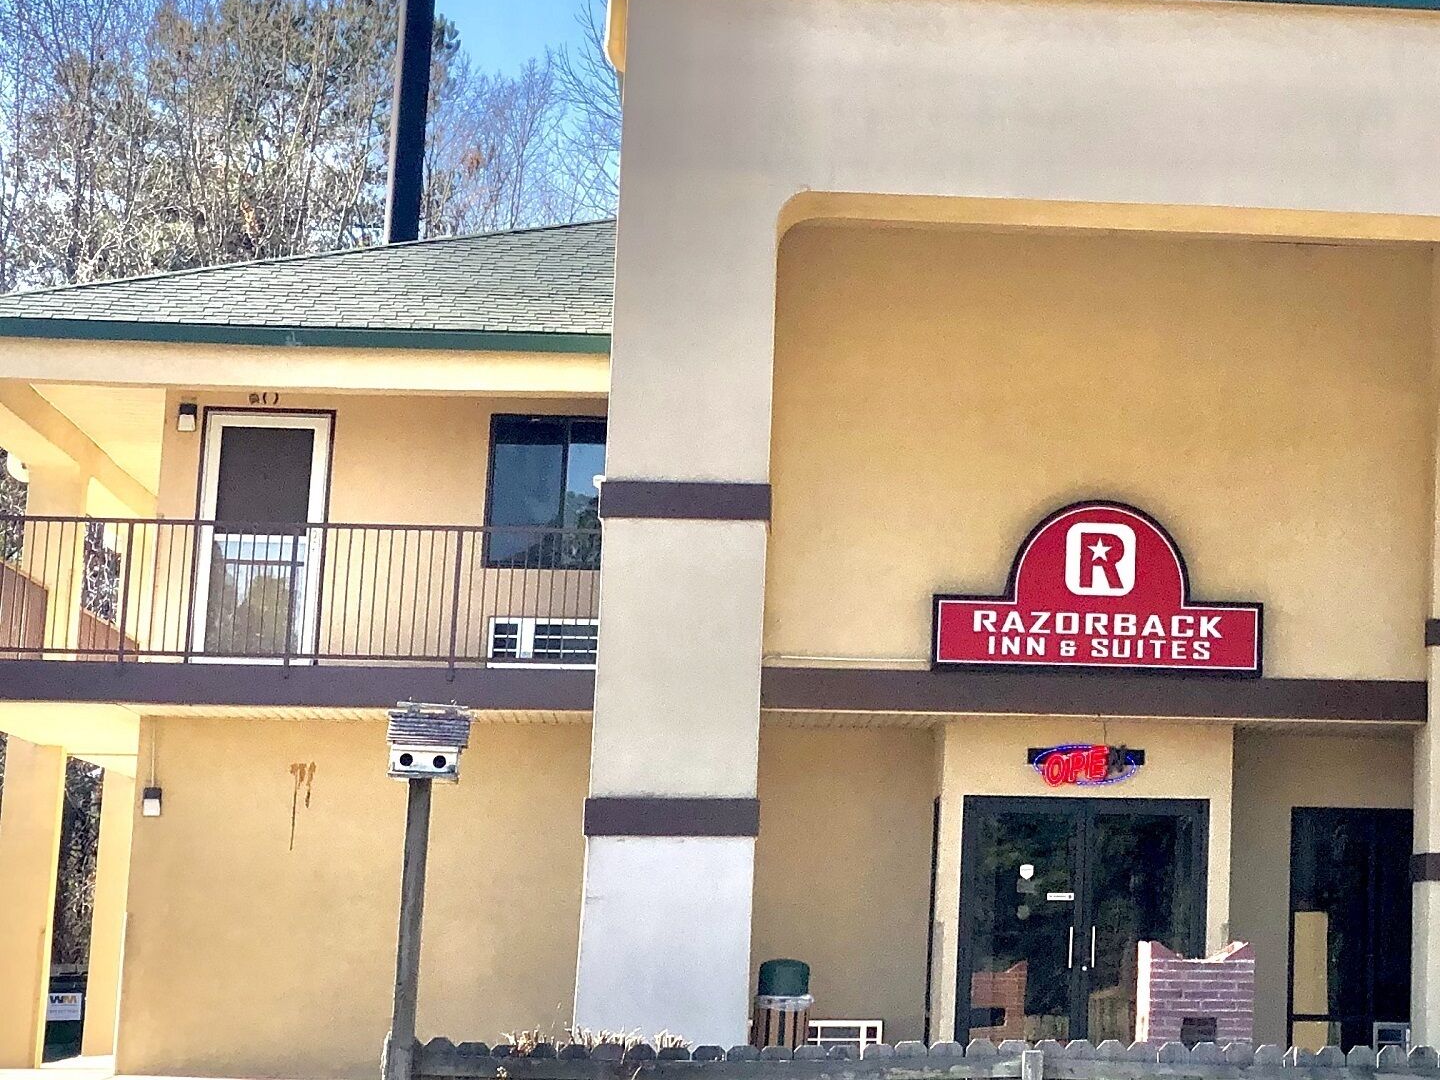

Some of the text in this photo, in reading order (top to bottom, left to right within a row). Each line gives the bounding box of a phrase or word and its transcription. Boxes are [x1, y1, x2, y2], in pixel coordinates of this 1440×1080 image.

[973, 610, 1223, 639] RAZORBACK
[988, 635, 1212, 661] INN & SUITES
[1044, 743, 1128, 788] OPEN
[49, 995, 77, 1004] WM
